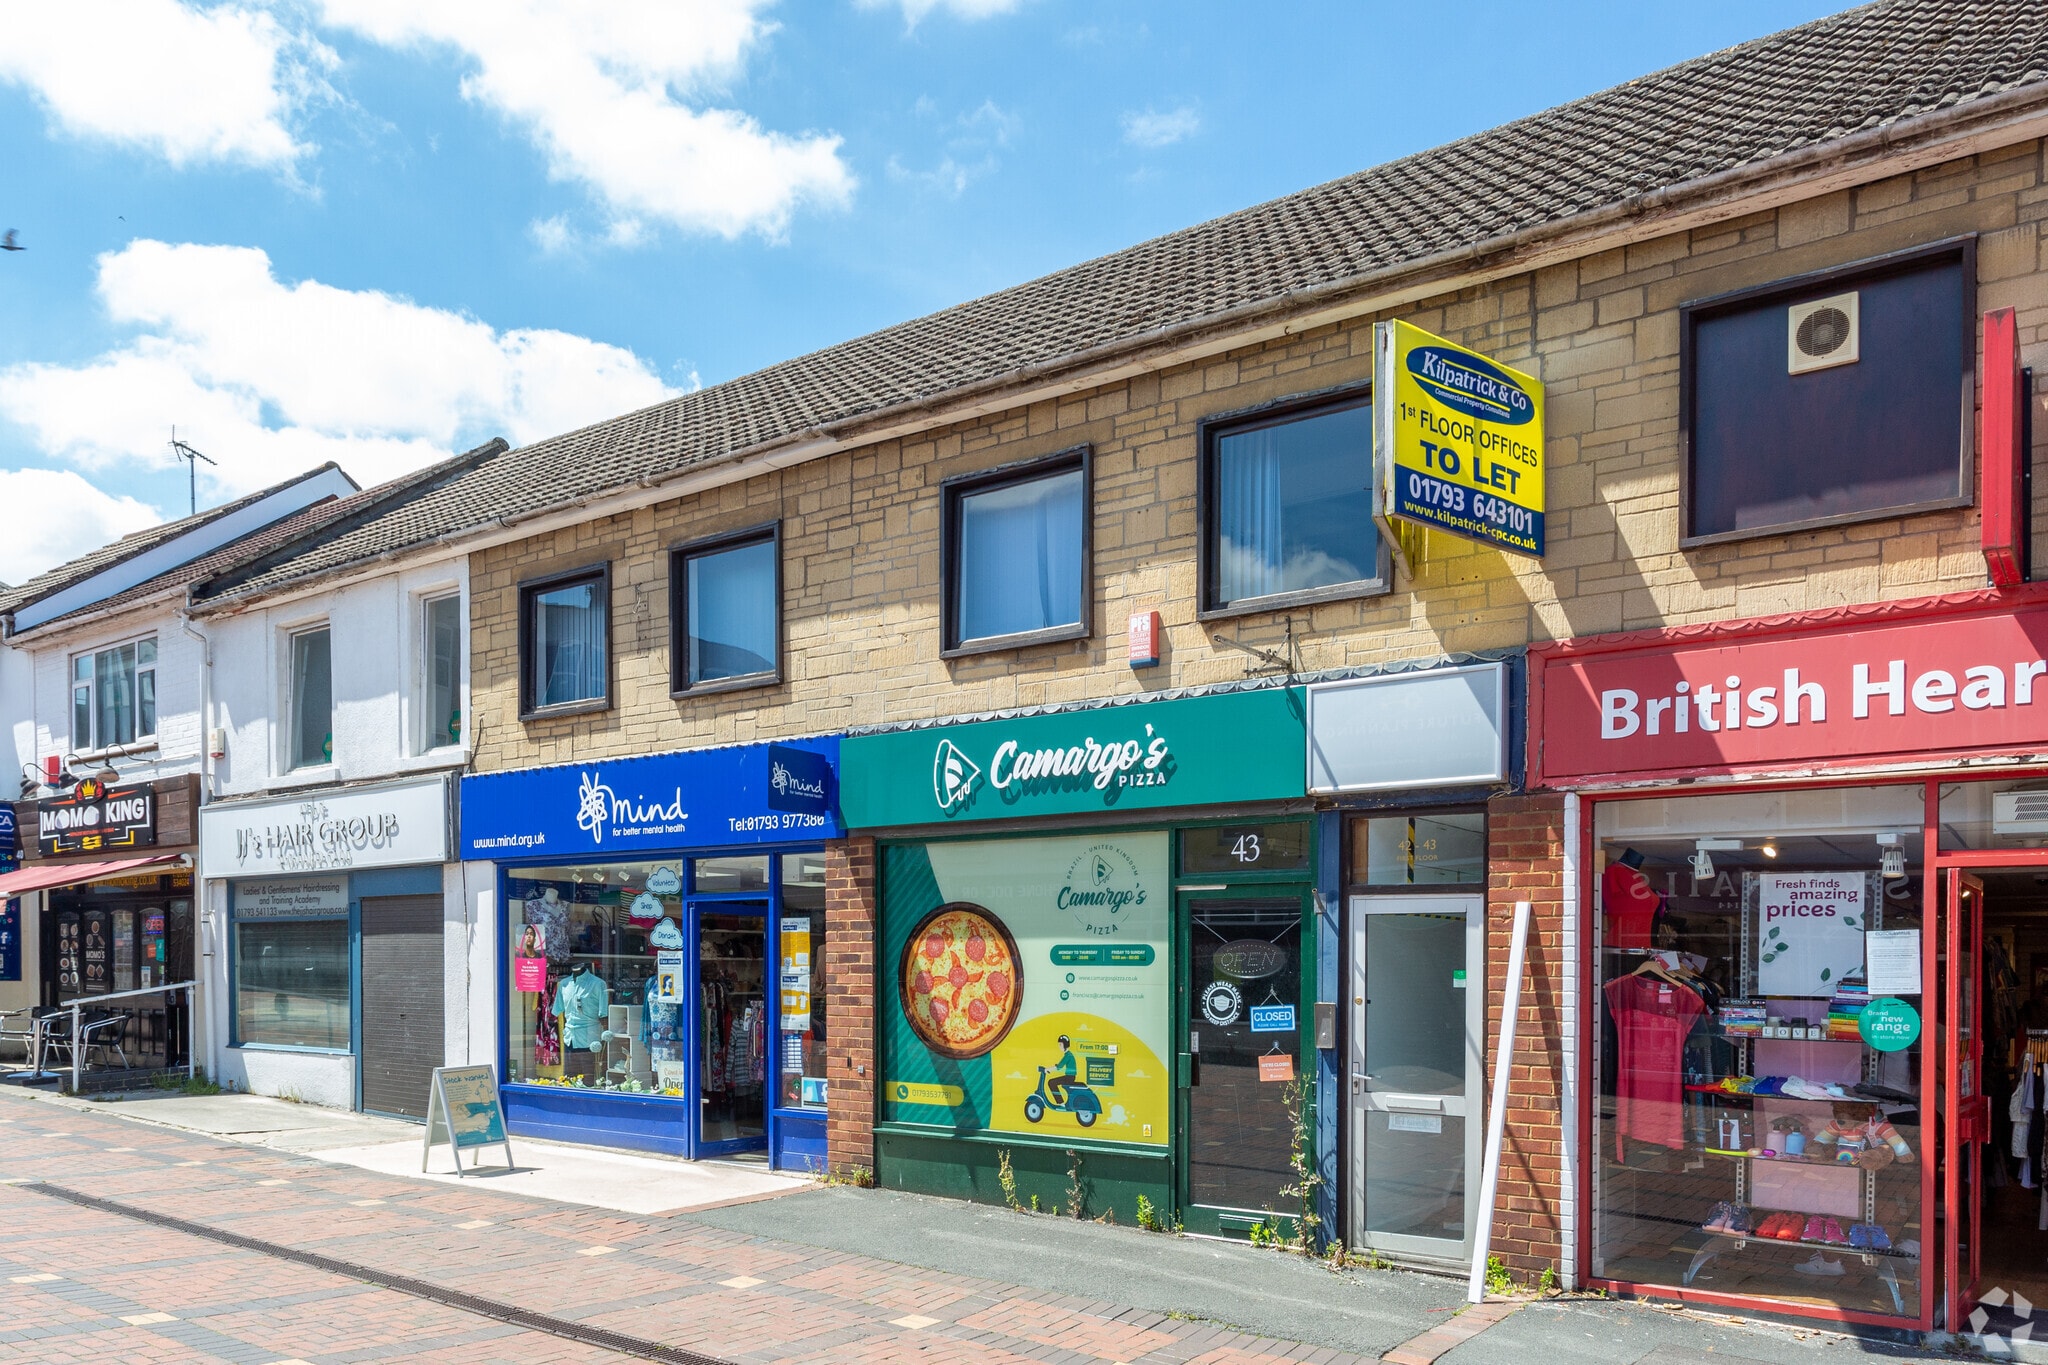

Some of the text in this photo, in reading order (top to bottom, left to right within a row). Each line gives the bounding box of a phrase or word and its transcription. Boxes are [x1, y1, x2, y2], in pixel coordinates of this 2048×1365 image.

[1421, 351, 1527, 410] Kilpatrick & Co
[1434, 387, 1511, 419] Commercial Property Consultants
[1400, 402, 1538, 468] 1st FLOOR OFFICES
[1420, 440, 1521, 495] TO LET
[1409, 473, 1533, 535] 01793 643101
[1404, 500, 1537, 551] www.kilpatrick-cpc.co.uk
[1600, 668, 1826, 739] British
[990, 723, 1169, 790] Camargo's
[790, 778, 825, 794] mind
[1118, 772, 1166, 788] PIZZA
[611, 786, 689, 825] mind
[43, 805, 100, 832] MOMO
[105, 798, 145, 823] KING
[729, 815, 779, 832] Tel:01793
[266, 821, 314, 849] HAIR
[319, 812, 397, 845] GROUP
[613, 823, 686, 837] for better mental health
[473, 832, 545, 849] www.mind.org.uk
[1231, 834, 1260, 863] 43
[1398, 840, 1412, 851] 42
[1423, 838, 1437, 851] 43
[1066, 844, 1139, 880] BRAZIL UNITED KINGDOM
[261, 886, 267, 894] &
[302, 882, 340, 894] Hairdressing
[652, 880, 676, 888] Volunteer
[1775, 878, 1841, 889] Fresh finds
[259, 894, 321, 906] and Training Academy
[1057, 882, 1148, 914] Camargo's
[1789, 888, 1858, 903] amazing
[236, 907, 255, 918] 01793
[255, 906, 278, 917] 541133
[641, 901, 653, 911] Shop
[1766, 900, 1836, 922] prices
[658, 931, 676, 940] Donate
[1086, 923, 1119, 936] PIZZA
[1221, 951, 1276, 967] OPEN
[1202, 982, 1217, 1000] PLEASE
[1231, 987, 1242, 1004] MASK
[1202, 1008, 1240, 1026] AND KEEP DISTANCE
[1253, 1011, 1292, 1022] CLOSED
[1881, 1015, 1904, 1023] new
[1871, 1023, 1911, 1035] range
[444, 1076, 462, 1084] Stock
